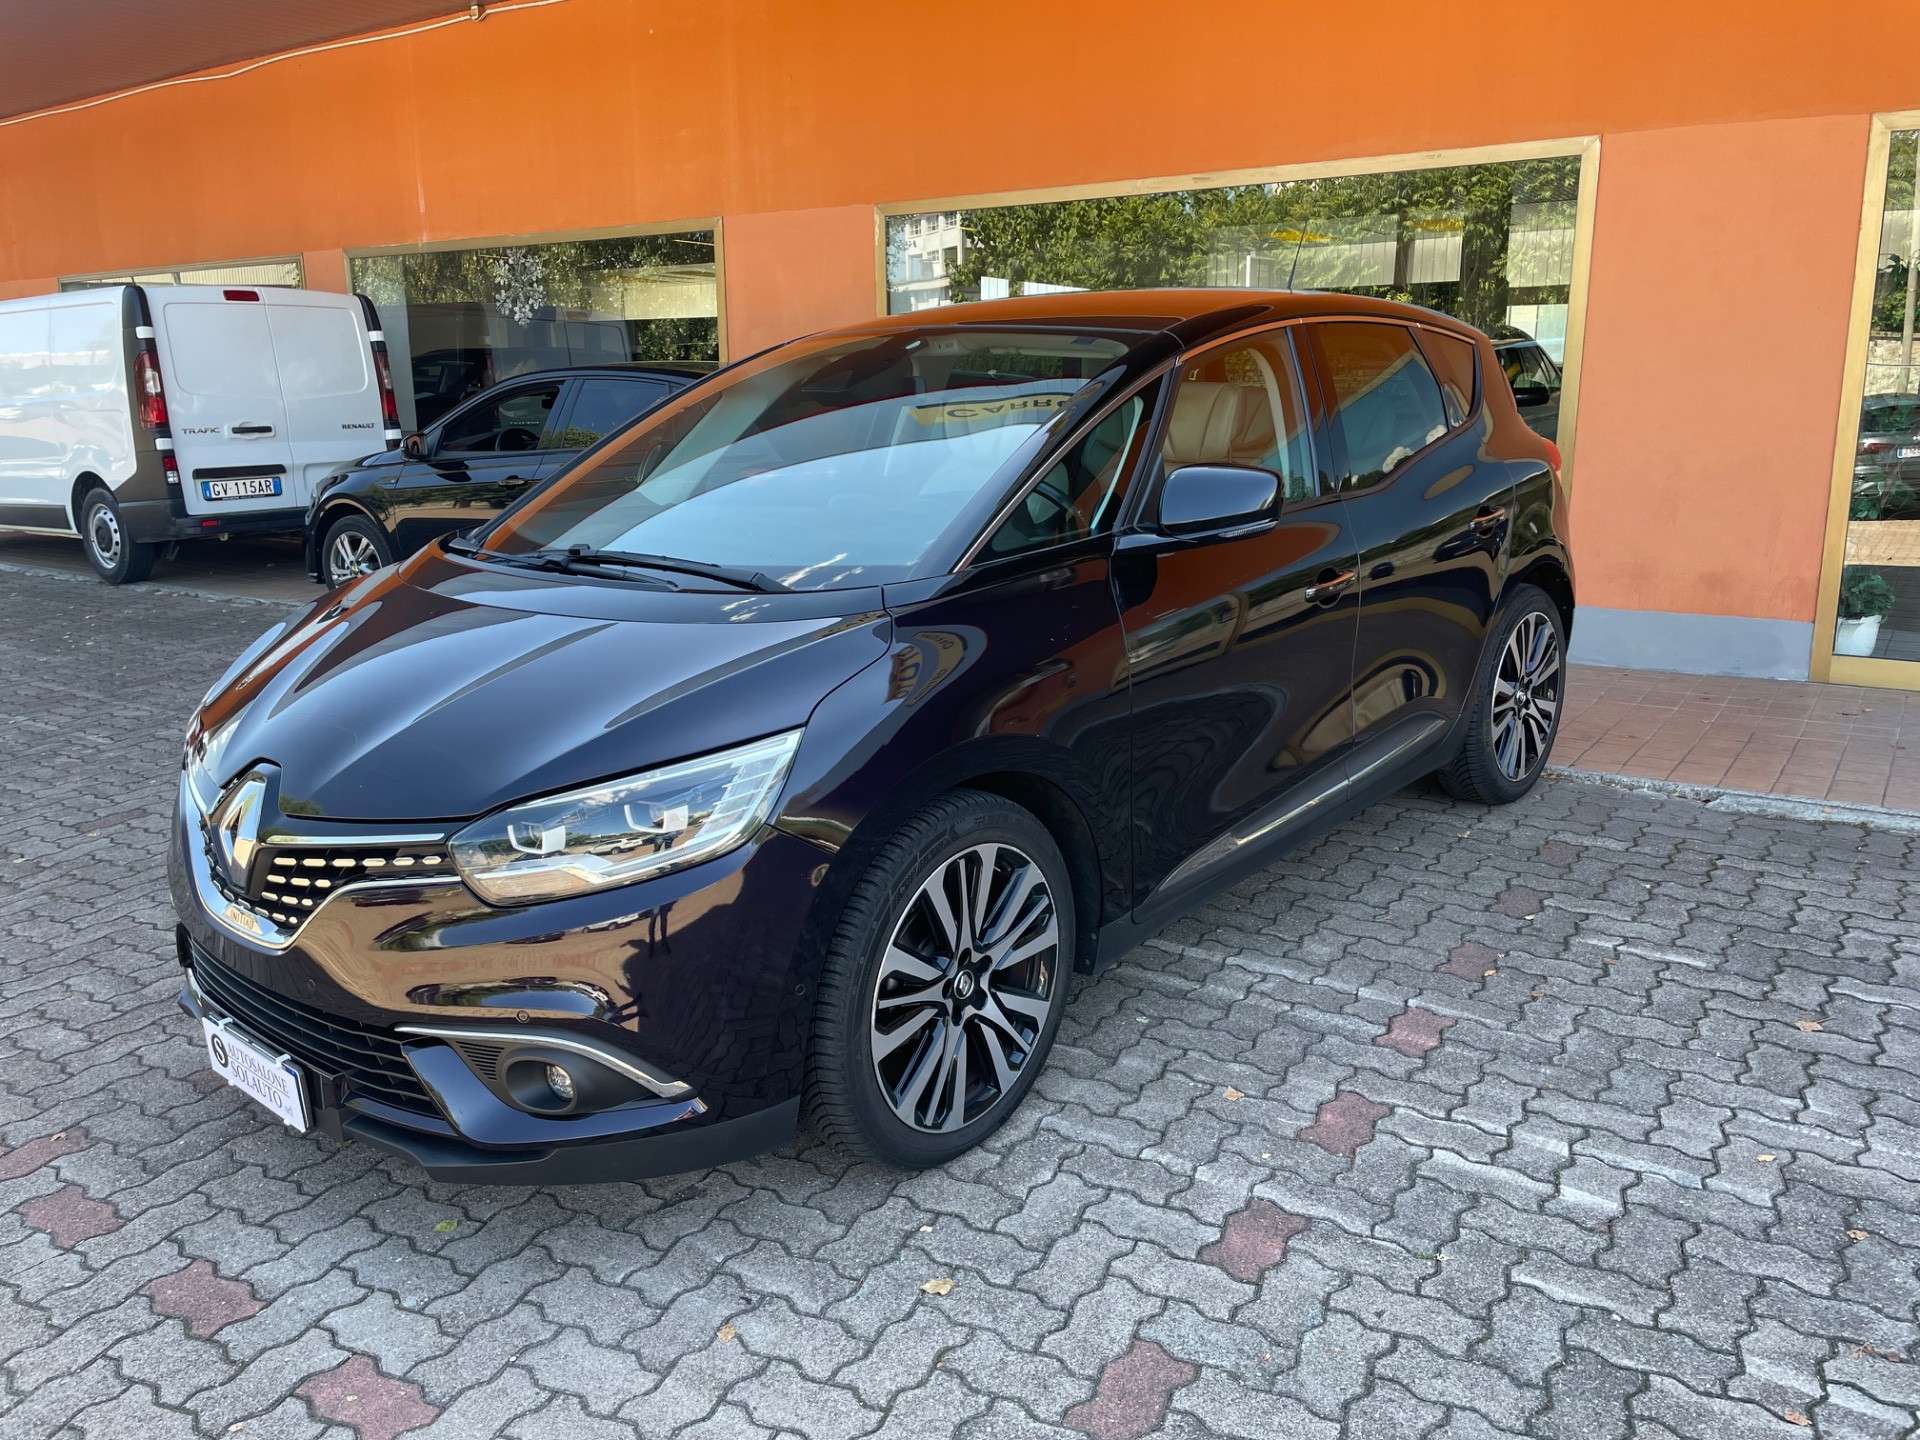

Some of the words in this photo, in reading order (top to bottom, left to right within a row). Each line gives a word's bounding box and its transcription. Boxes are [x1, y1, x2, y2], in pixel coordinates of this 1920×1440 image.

[181, 427, 220, 435] TRAFIC
[341, 422, 375, 430] RENAULT
[227, 1041, 288, 1094] AUTOSALONE
[230, 1059, 282, 1109] SOLAUTO
